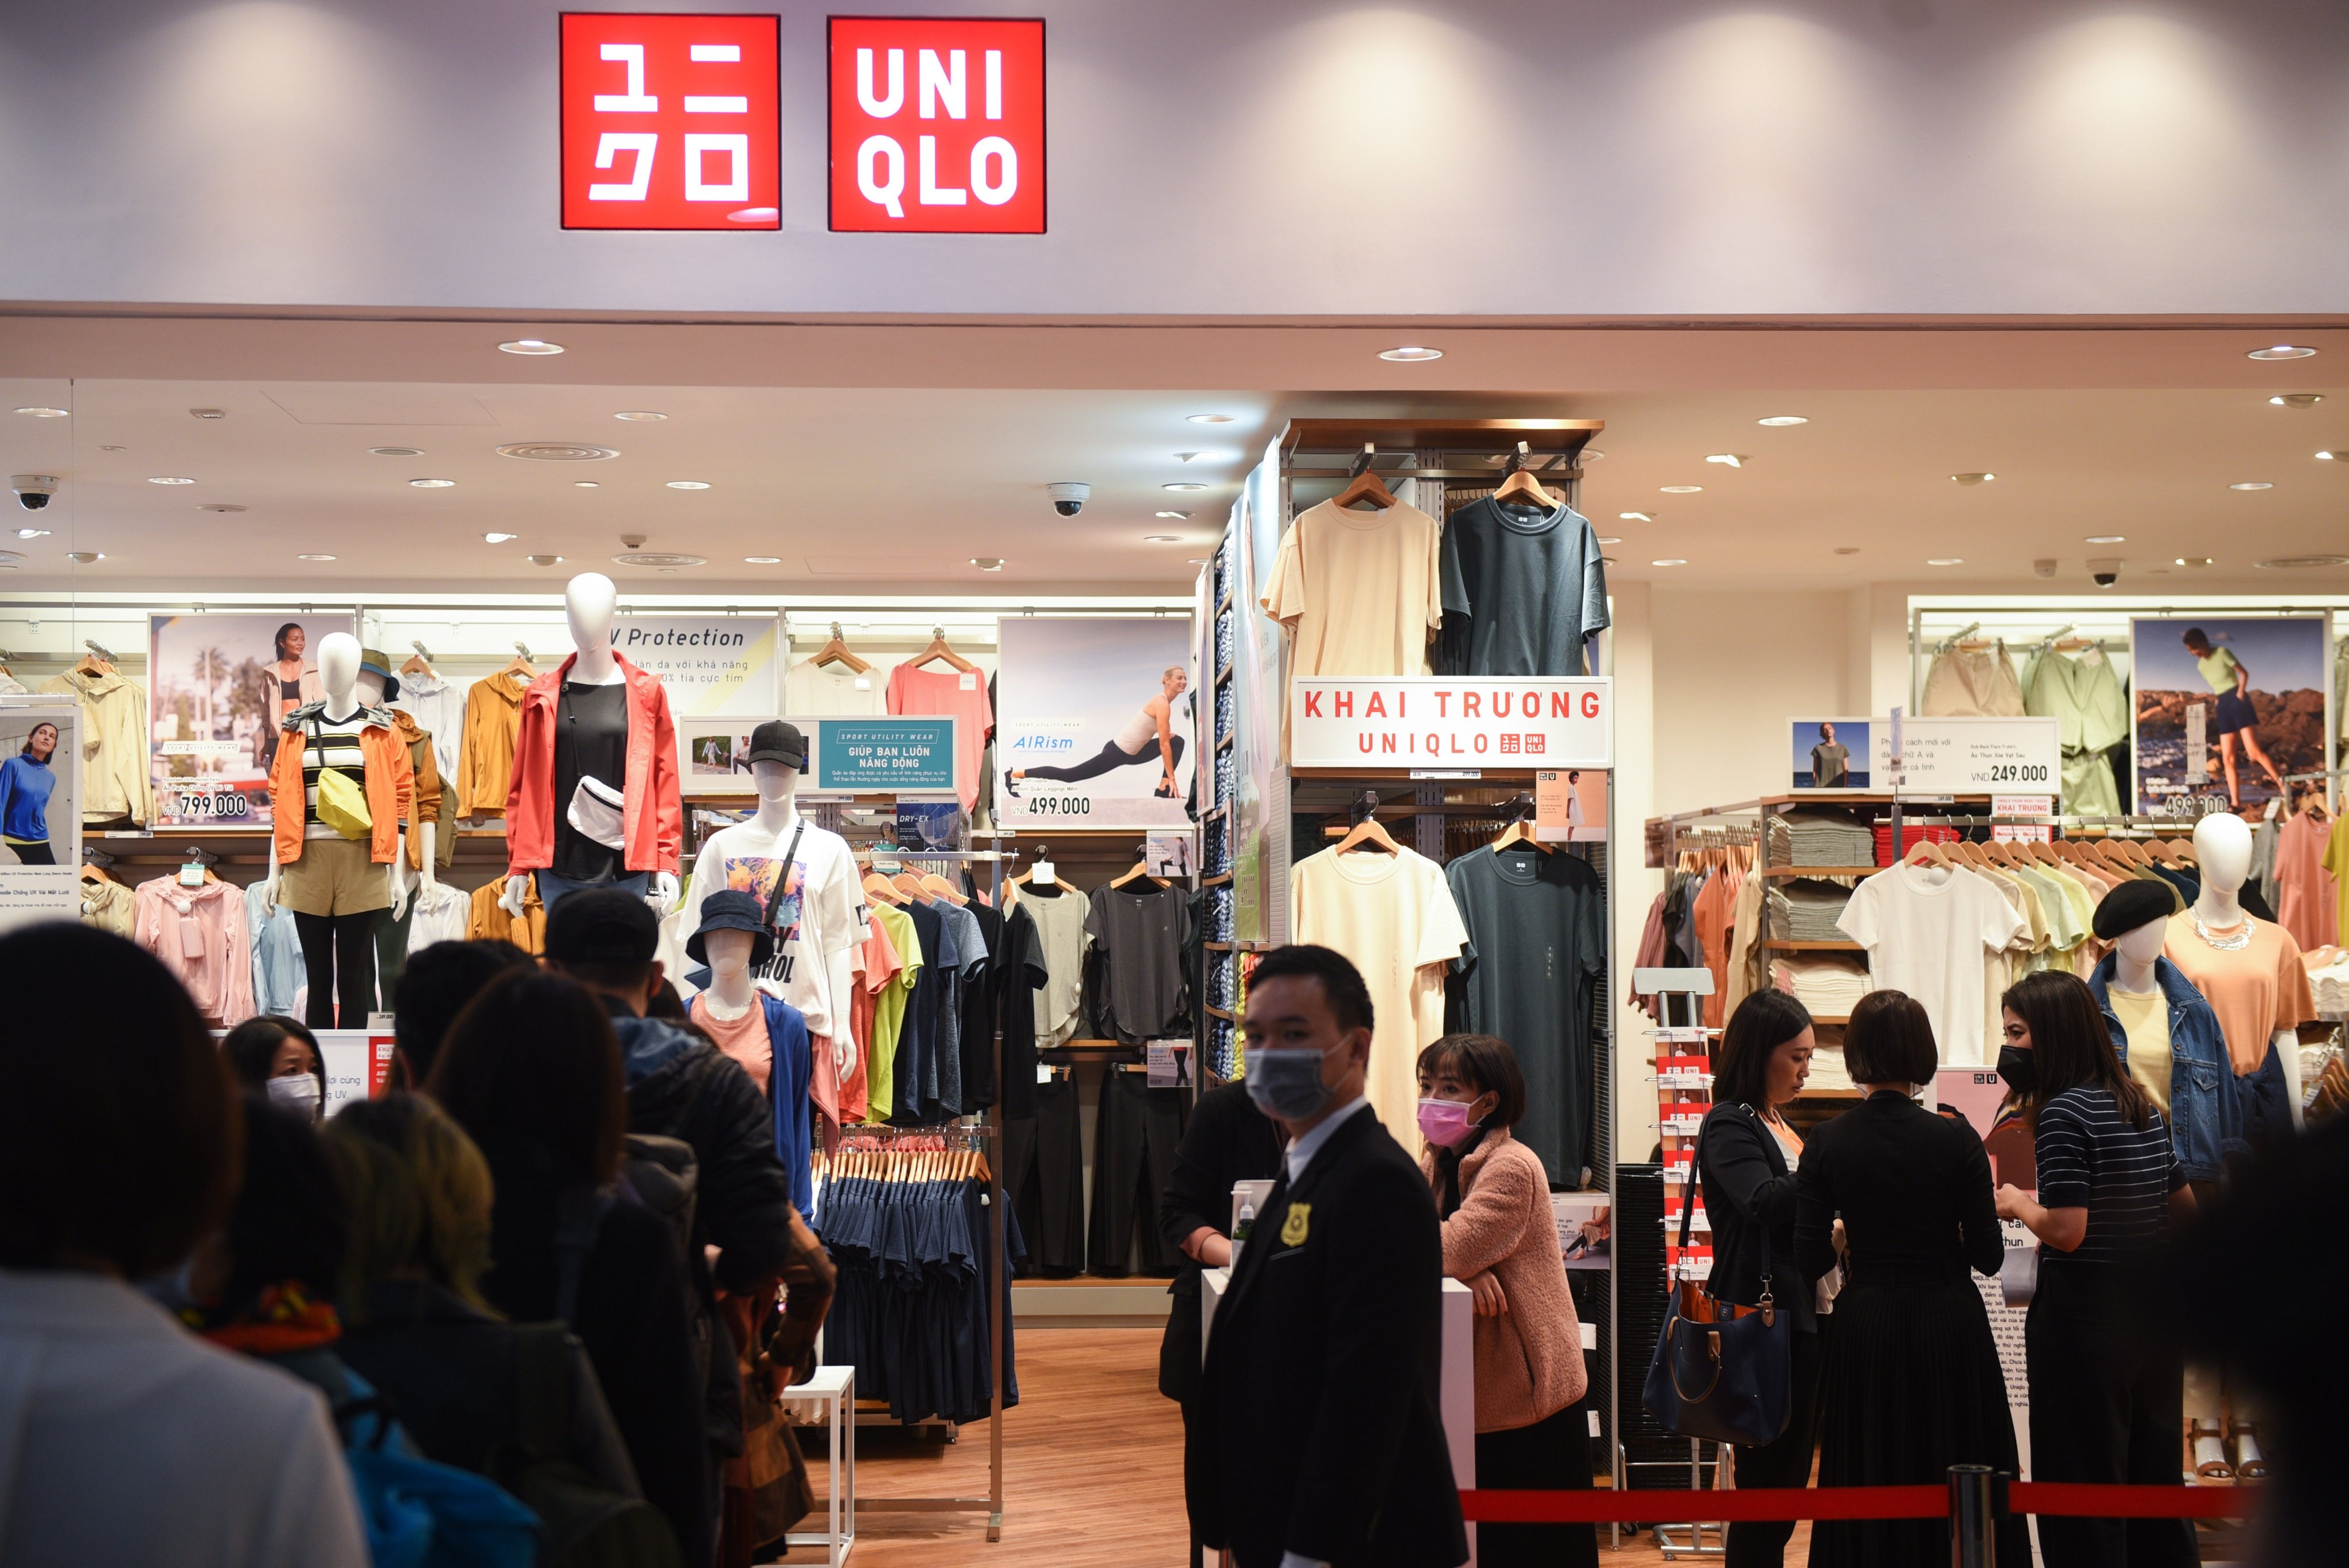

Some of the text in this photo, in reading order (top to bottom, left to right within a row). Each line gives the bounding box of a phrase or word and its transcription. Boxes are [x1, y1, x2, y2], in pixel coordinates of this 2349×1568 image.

[594, 44, 747, 112] ユニ
[857, 48, 1002, 119] UNI
[589, 133, 749, 201] クロ
[857, 135, 1018, 218] QLO
[628, 629, 744, 646] Protection
[658, 660, 669, 669] da
[676, 660, 691, 669] với
[722, 661, 748, 670] năng
[681, 674, 694, 682] tia
[700, 674, 719, 684] cực
[726, 673, 743, 682] tím
[1305, 691, 1599, 719] KHAI TRƯƠNG
[1012, 736, 1073, 748] AIRism
[1359, 733, 1487, 757] UNIQLO
[1527, 736, 1542, 744] UNI
[1527, 744, 1543, 752] QLO
[849, 745, 930, 758] GIÚP BẠN LUÔN
[859, 756, 919, 770] NĂNG ĐỘNG
[1971, 765, 2047, 781] VND 249.000
[163, 796, 246, 814] VND 799.000
[1029, 797, 1090, 814] 499.000
[340, 1076, 360, 1086] cùng
[1989, 1075, 1995, 1083] U
